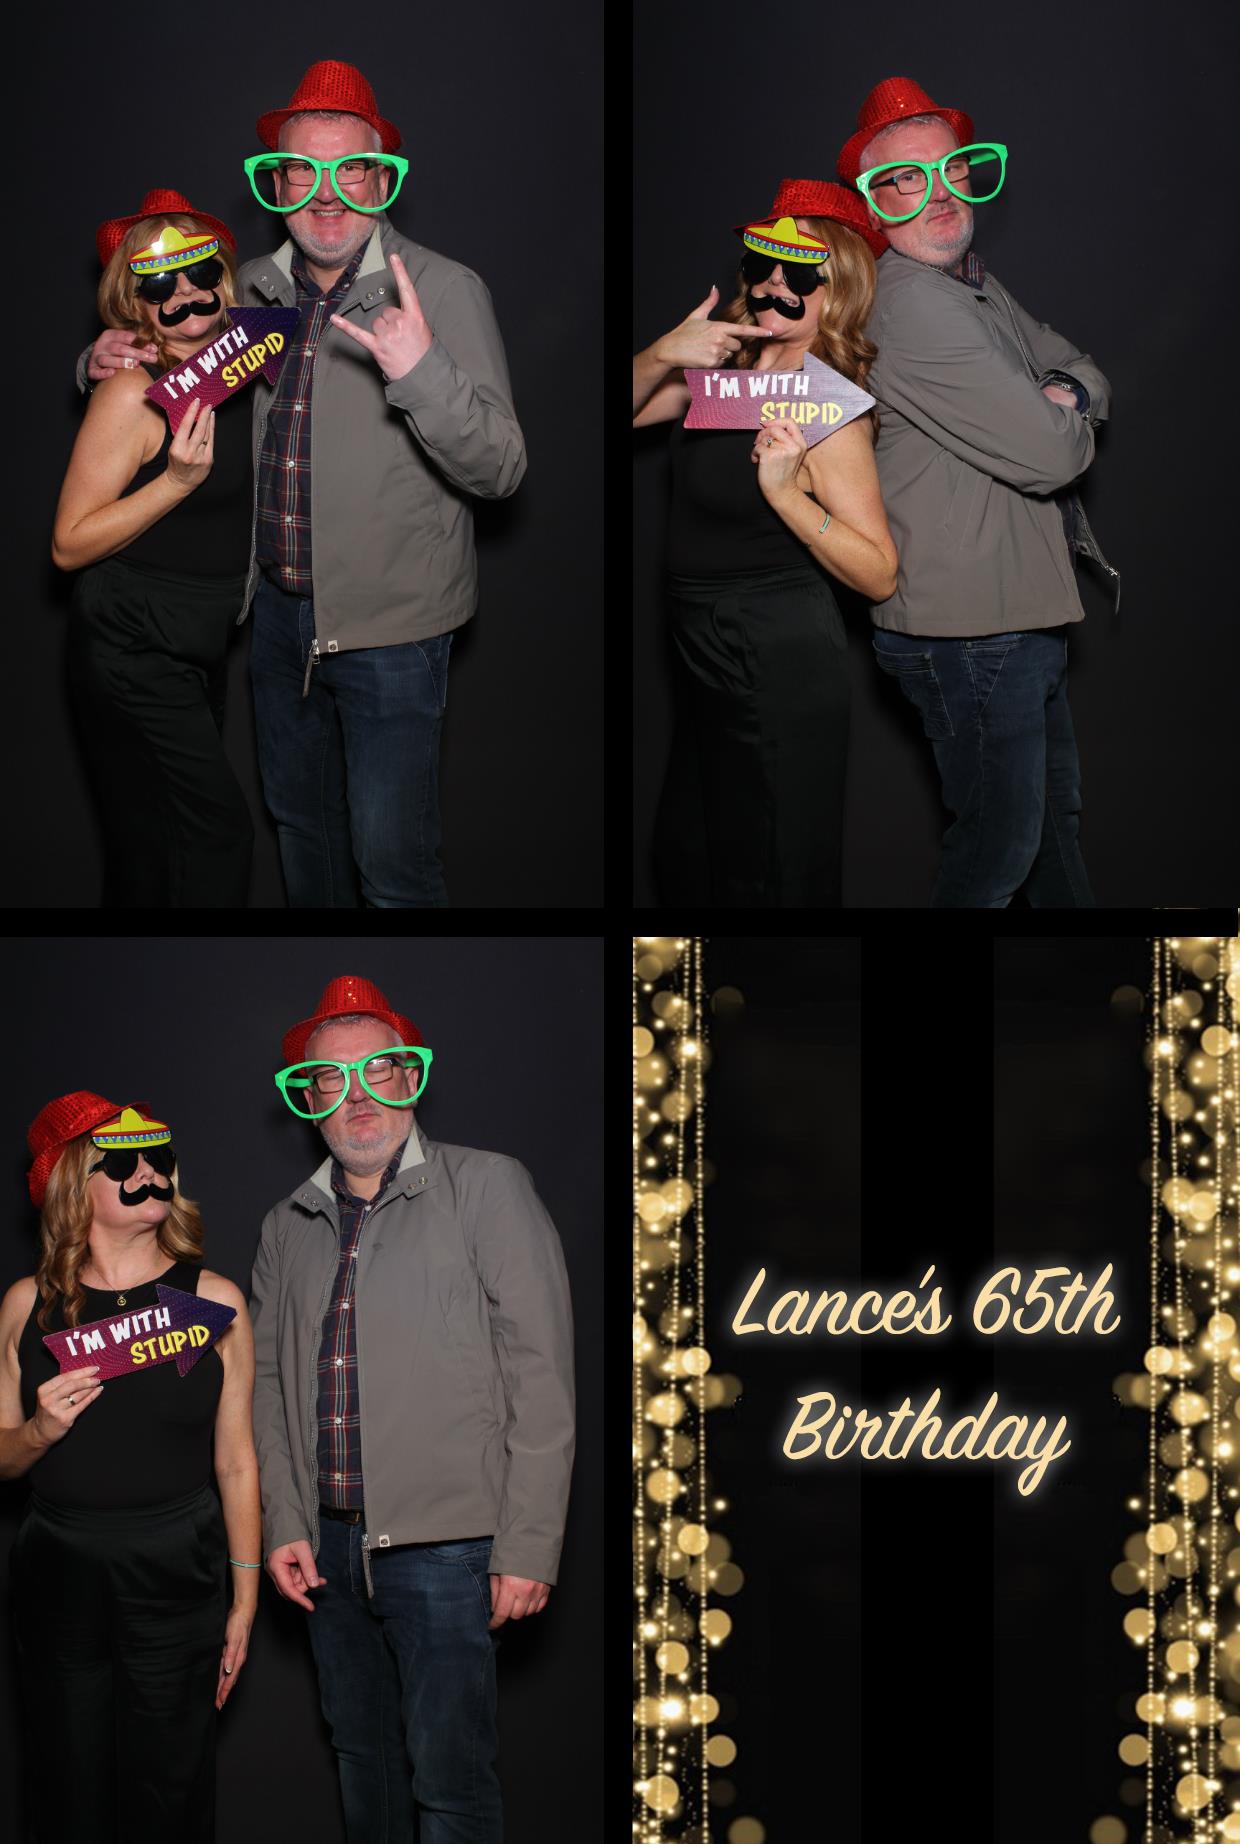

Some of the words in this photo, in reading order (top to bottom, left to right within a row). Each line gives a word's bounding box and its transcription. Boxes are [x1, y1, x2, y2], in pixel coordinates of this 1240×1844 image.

[163, 367, 200, 400] I'M
[197, 326, 249, 375] WITH
[221, 332, 285, 388] STUPID
[704, 372, 741, 399] I'M
[748, 373, 810, 398] WITH
[760, 401, 843, 425] STUPID
[65, 1329, 106, 1356] I'M
[109, 1307, 171, 1344] WITH
[130, 1325, 210, 1364] STUPID
